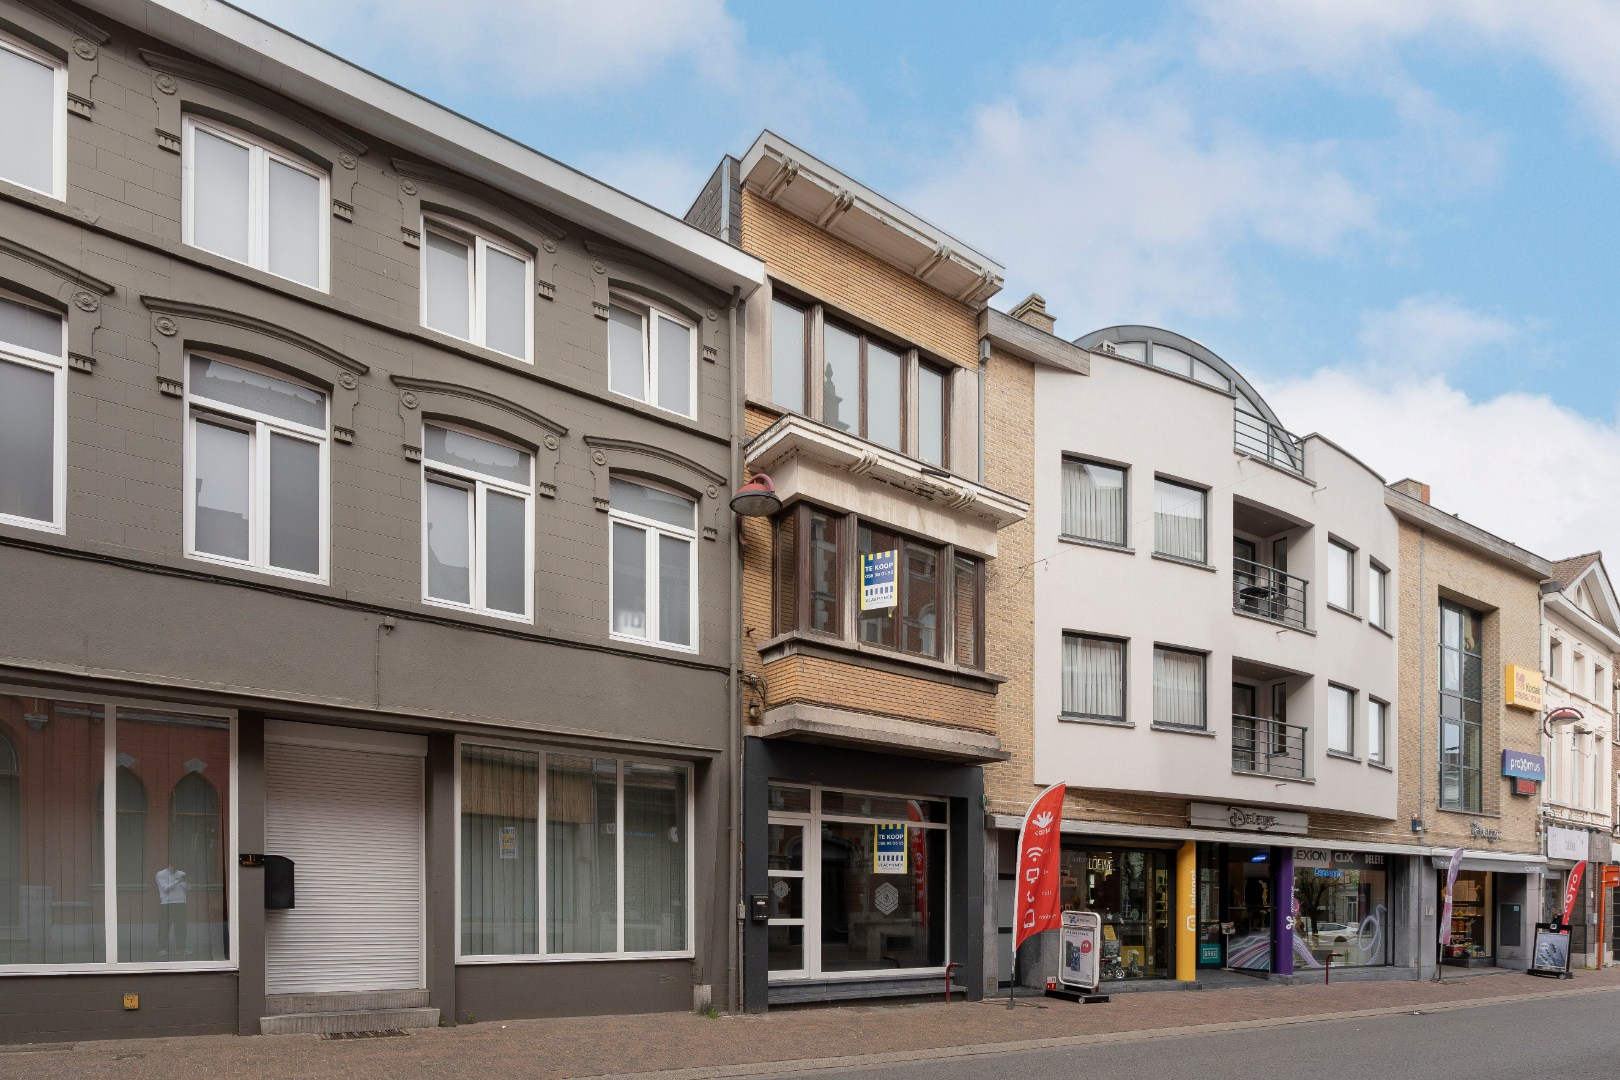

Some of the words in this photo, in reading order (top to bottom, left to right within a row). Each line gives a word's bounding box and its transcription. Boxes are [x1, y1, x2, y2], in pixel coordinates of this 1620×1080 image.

[875, 563, 894, 571] KOOP
[1526, 682, 1541, 695] Kodak
[1510, 758, 1541, 772] proximus
